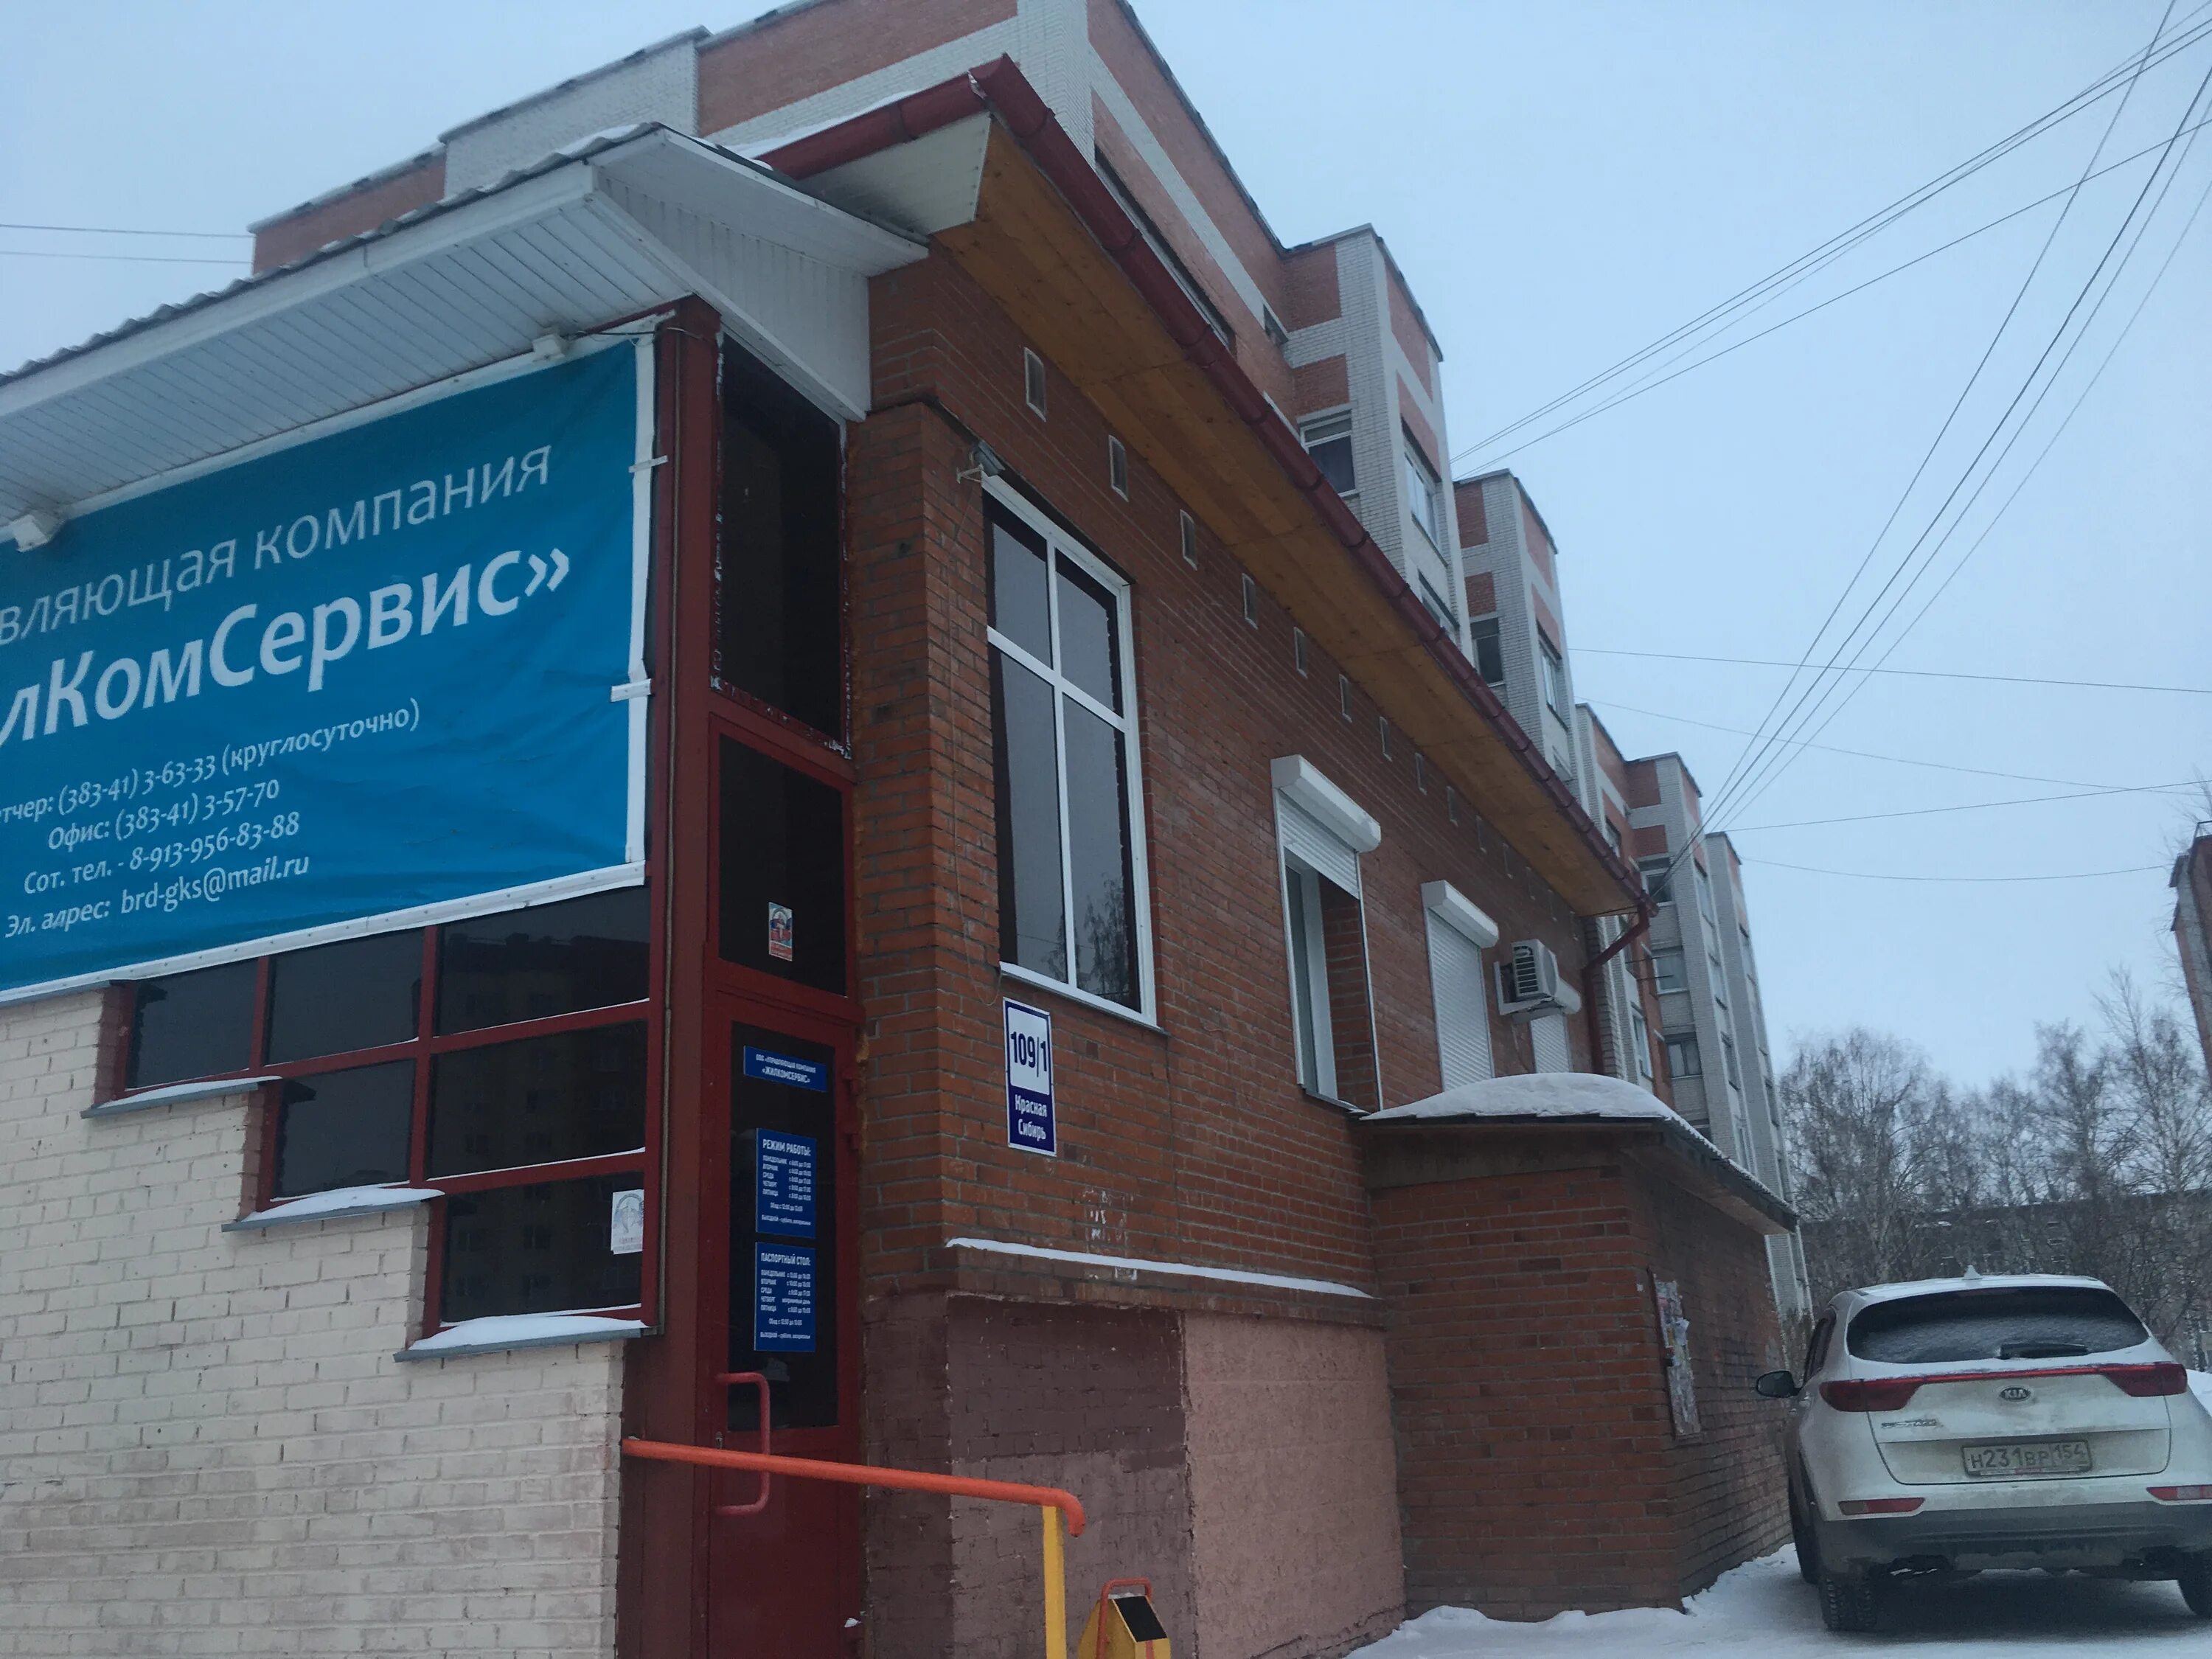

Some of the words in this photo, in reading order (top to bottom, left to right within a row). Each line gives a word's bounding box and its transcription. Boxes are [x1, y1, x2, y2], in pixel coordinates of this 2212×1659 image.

[0, 539, 236, 645] вляющая
[255, 445, 552, 567] компания
[0, 548, 570, 745] лКомСервис»
[0, 796, 54, 823] тчер:
[58, 768, 138, 815] (383-41)
[144, 754, 215, 794] 3-63-33
[222, 698, 420, 775] (круглосуточно)
[48, 821, 110, 852] Офис:
[115, 793, 198, 841] (383-41)
[204, 779, 279, 820] 3-57-70
[24, 871, 65, 894] Сот.
[72, 860, 112, 883] тел.
[129, 812, 299, 876] 8-913-956-83-88
[5, 914, 36, 938] Эл.
[42, 898, 110, 934] адрес:
[121, 855, 309, 915] brd-gks@mail.ru
[1009, 1031, 1048, 1077] 109/1
[1015, 1093, 1048, 1118] Красная
[1018, 1118, 1047, 1141] Сибирь
[762, 1138, 785, 1152] РЕЖИМ
[786, 1143, 811, 1156] РАБОТЫ:
[761, 1253, 796, 1265] ПАСПОРТНЫЙ
[2002, 1388, 2028, 1400] KIA
